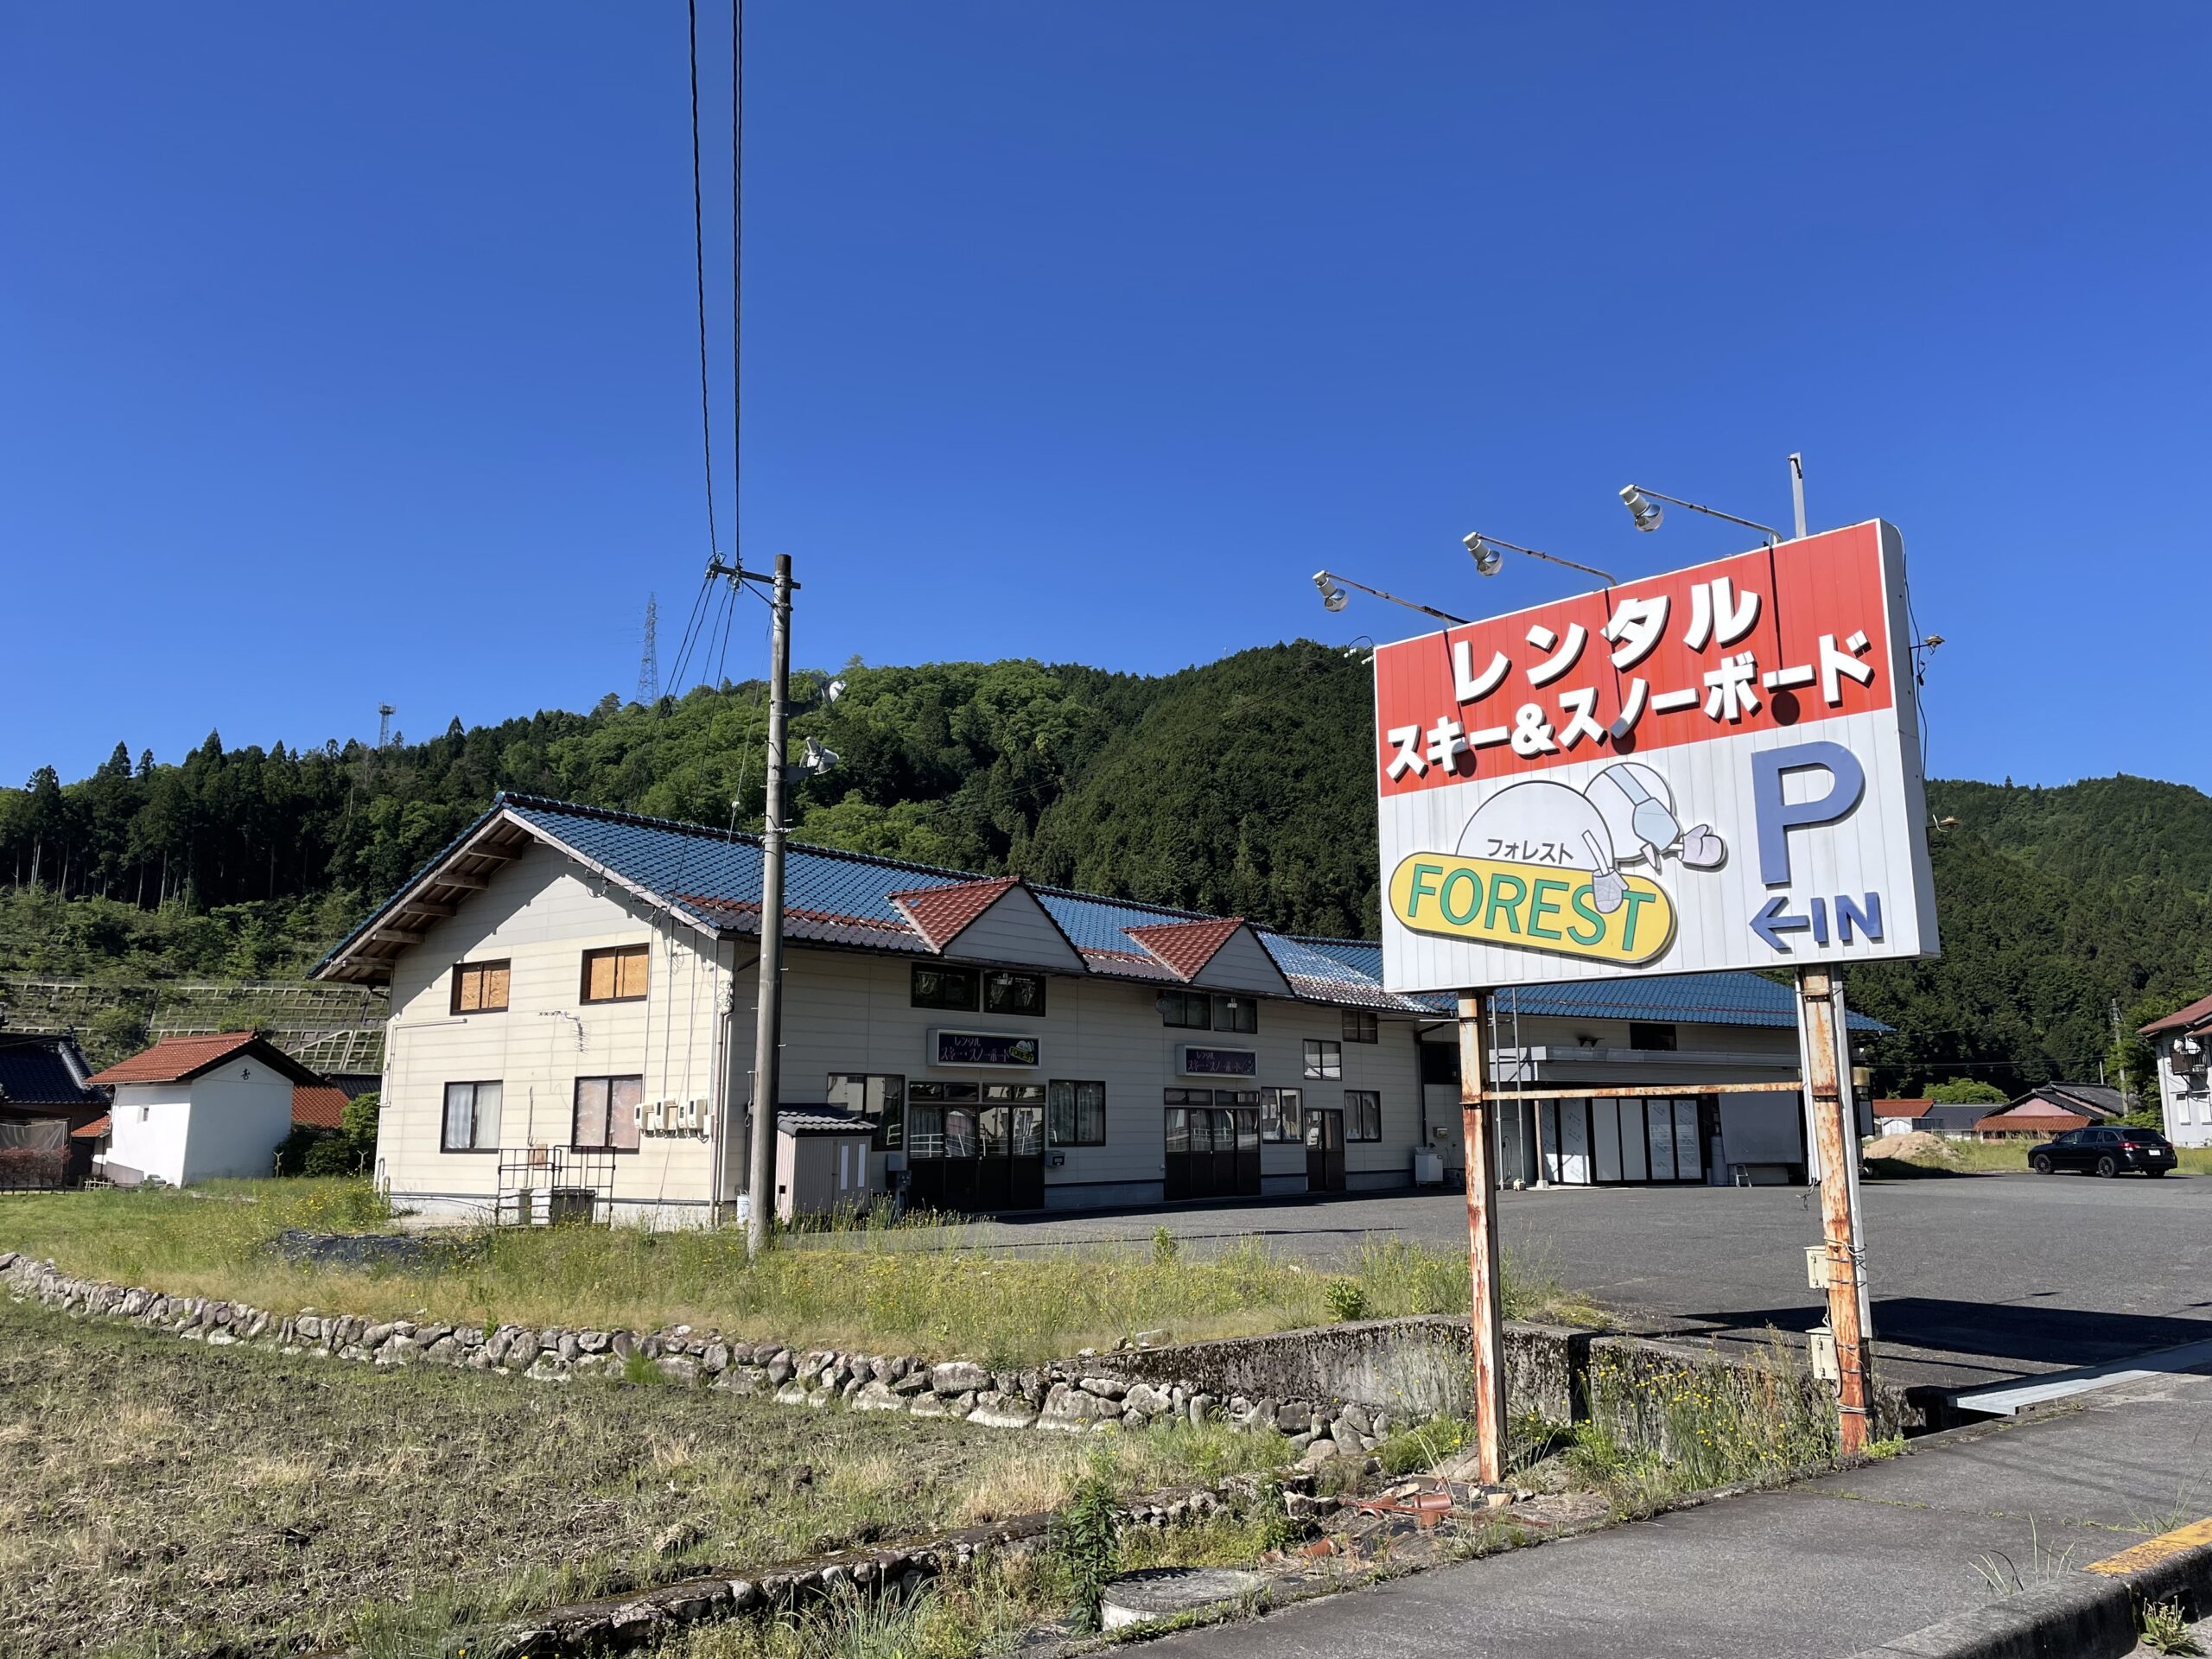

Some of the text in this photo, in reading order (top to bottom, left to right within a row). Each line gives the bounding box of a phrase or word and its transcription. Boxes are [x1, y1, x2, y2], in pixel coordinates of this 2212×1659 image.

[1453, 575, 1761, 703] レンタル
[1385, 629, 1874, 779] スキー&スノーボード
[1487, 838, 1574, 864] フォレスト
[1751, 741, 1866, 887] P
[1407, 862, 1657, 951] FOREST
[1810, 892, 1884, 944] IN
[954, 1036, 981, 1046] レンタル
